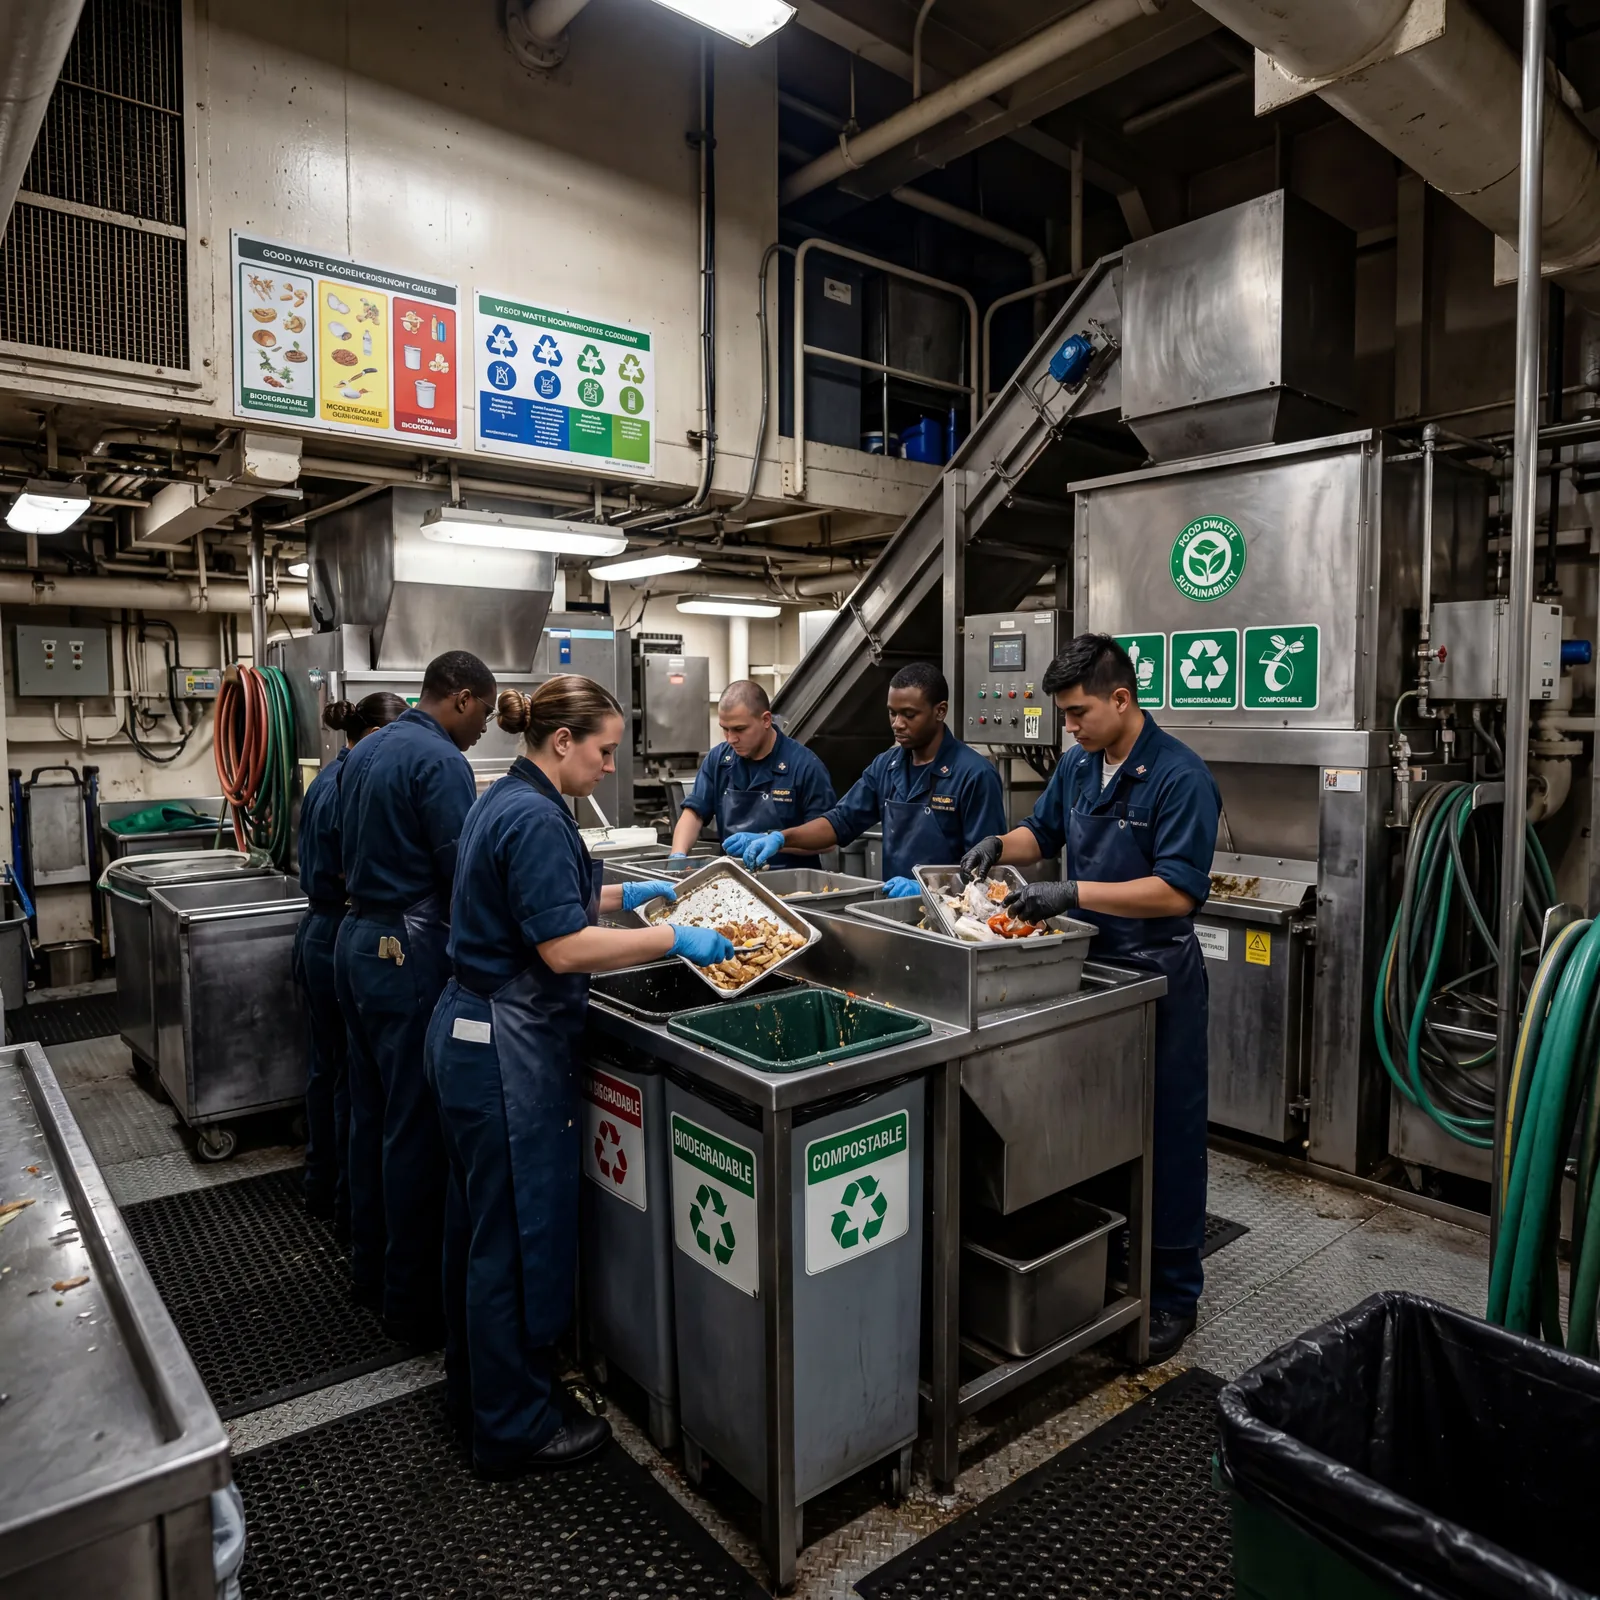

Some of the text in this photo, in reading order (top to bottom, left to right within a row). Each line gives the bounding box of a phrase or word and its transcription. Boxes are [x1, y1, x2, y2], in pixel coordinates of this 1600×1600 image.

[263, 249, 292, 262] GOOD
[293, 255, 325, 270] WASTE
[1176, 569, 1238, 598] SUSTAINABILITY
[1258, 696, 1303, 704] COMPOSTABLE
[674, 1128, 752, 1185] BIODEGRADABLE
[812, 1125, 903, 1173] COMPOSTABLE
